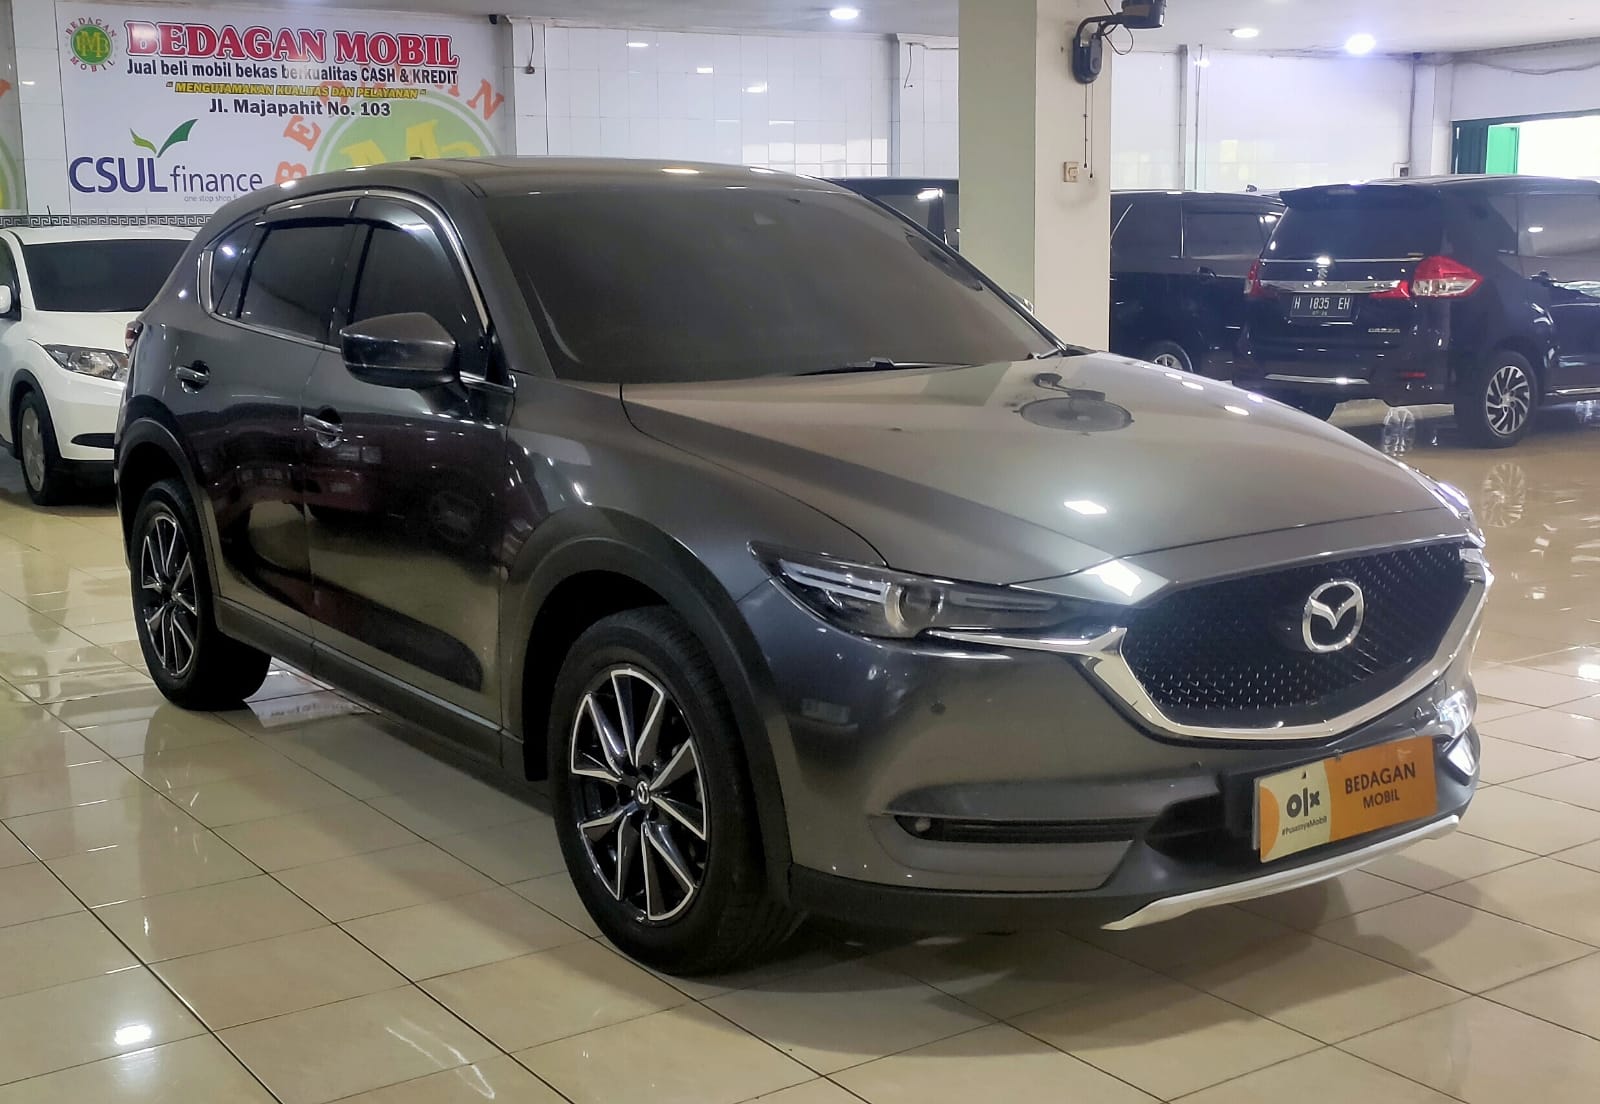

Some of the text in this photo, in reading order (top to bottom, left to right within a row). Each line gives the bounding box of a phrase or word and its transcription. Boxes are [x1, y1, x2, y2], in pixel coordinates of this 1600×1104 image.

[125, 20, 460, 67] BEDAGAN MOBIL
[70, 56, 115, 72] MOBIL
[127, 58, 156, 75] Jual
[160, 60, 188, 76] beli
[192, 62, 232, 77] mobil
[236, 63, 277, 79] bekas
[361, 67, 395, 82] CASH
[400, 69, 408, 82] &
[413, 69, 458, 84] KREDIT
[175, 82, 274, 95] MENGUTAMAKAN
[276, 85, 330, 96] KUALITAS
[331, 87, 354, 97] DAN
[356, 88, 418, 98] PELAYANAN
[209, 98, 391, 117] Jl. Majapahit No. 103
[68, 156, 263, 193] CSUL finance
[1294, 297, 1350, 309] H 1835 EH
[1345, 761, 1416, 795] BEDAGAN
[1286, 787, 1320, 818] olx
[1363, 789, 1400, 809] MOBIL
